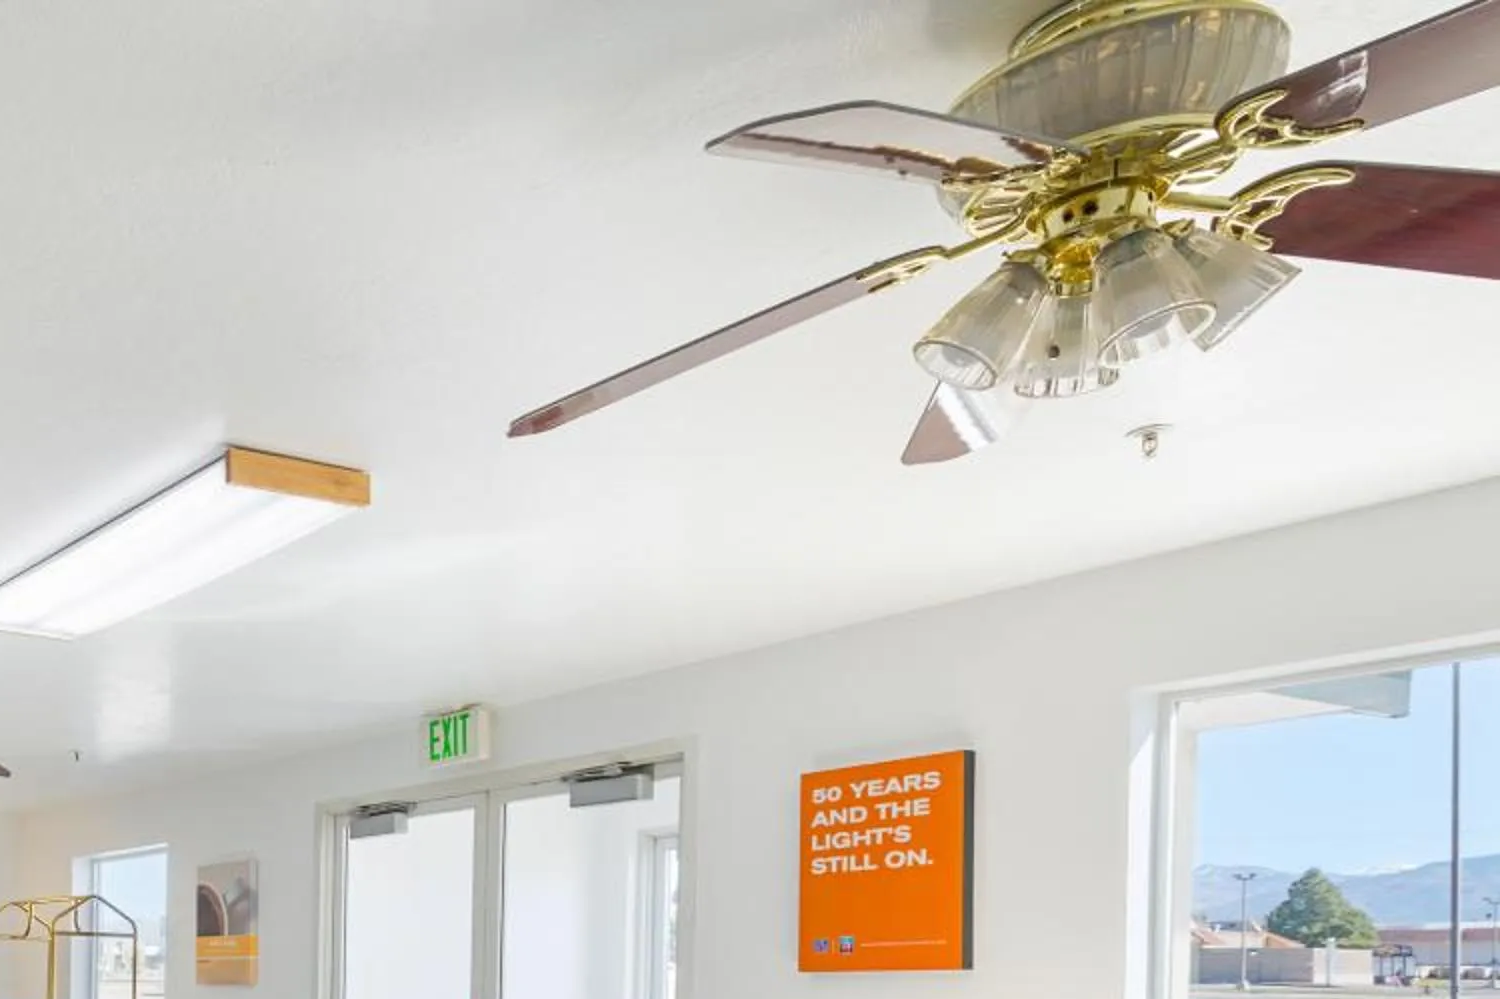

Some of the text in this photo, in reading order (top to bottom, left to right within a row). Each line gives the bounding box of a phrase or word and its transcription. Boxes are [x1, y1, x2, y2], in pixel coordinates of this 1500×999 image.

[430, 713, 469, 761] EXIT
[812, 771, 941, 805] 50 YEARS
[811, 798, 930, 828] AND THE
[811, 825, 911, 851] LIGHT'S
[811, 848, 934, 875] STILL ON.
